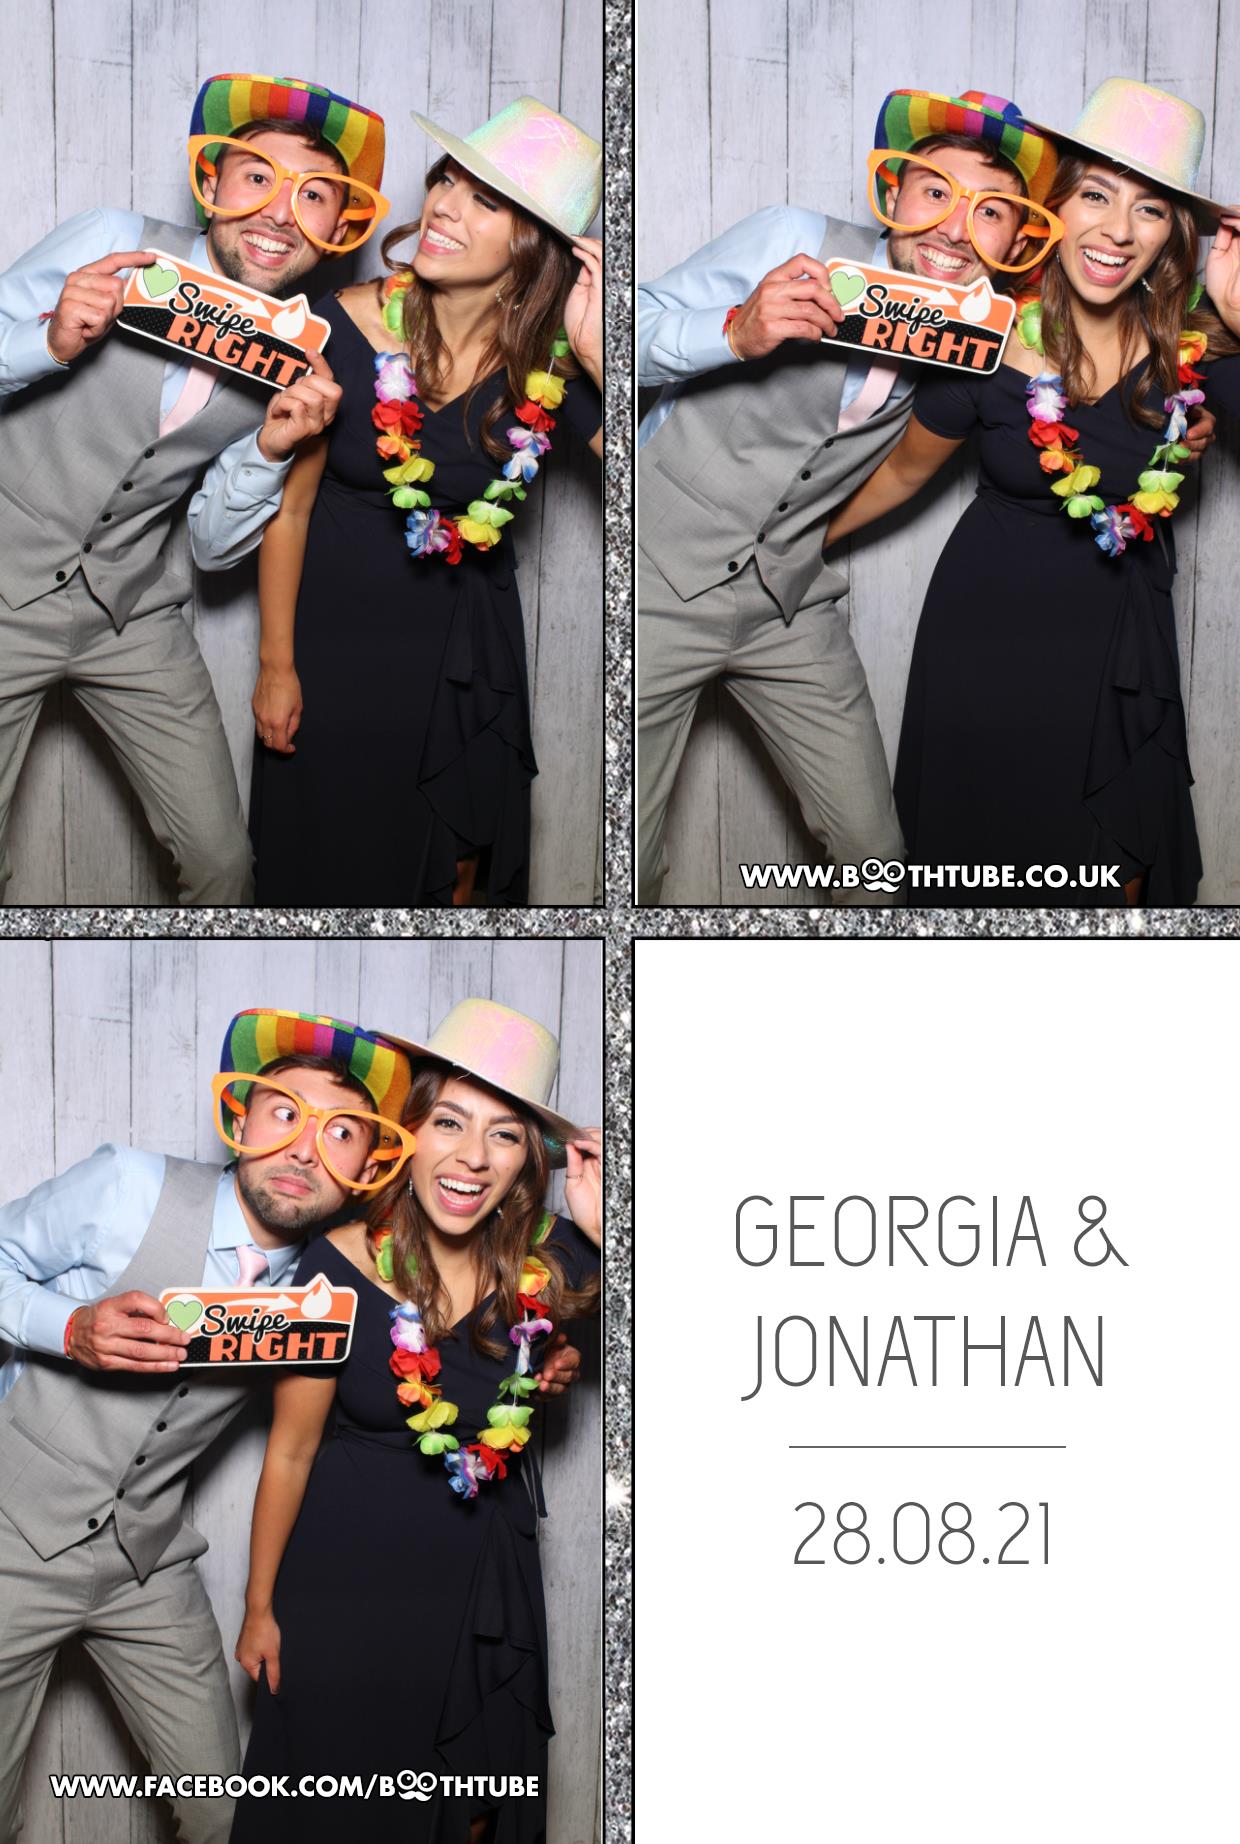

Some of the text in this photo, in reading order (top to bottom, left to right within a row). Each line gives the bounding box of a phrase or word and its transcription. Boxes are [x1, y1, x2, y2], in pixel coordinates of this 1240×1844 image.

[168, 282, 257, 339] Swipe
[859, 284, 946, 335] Swipe
[166, 313, 307, 386] RIGHT
[861, 318, 999, 369] RIGHT
[200, 1304, 290, 1343] Swipe
[209, 1332, 346, 1362] RIGHT
